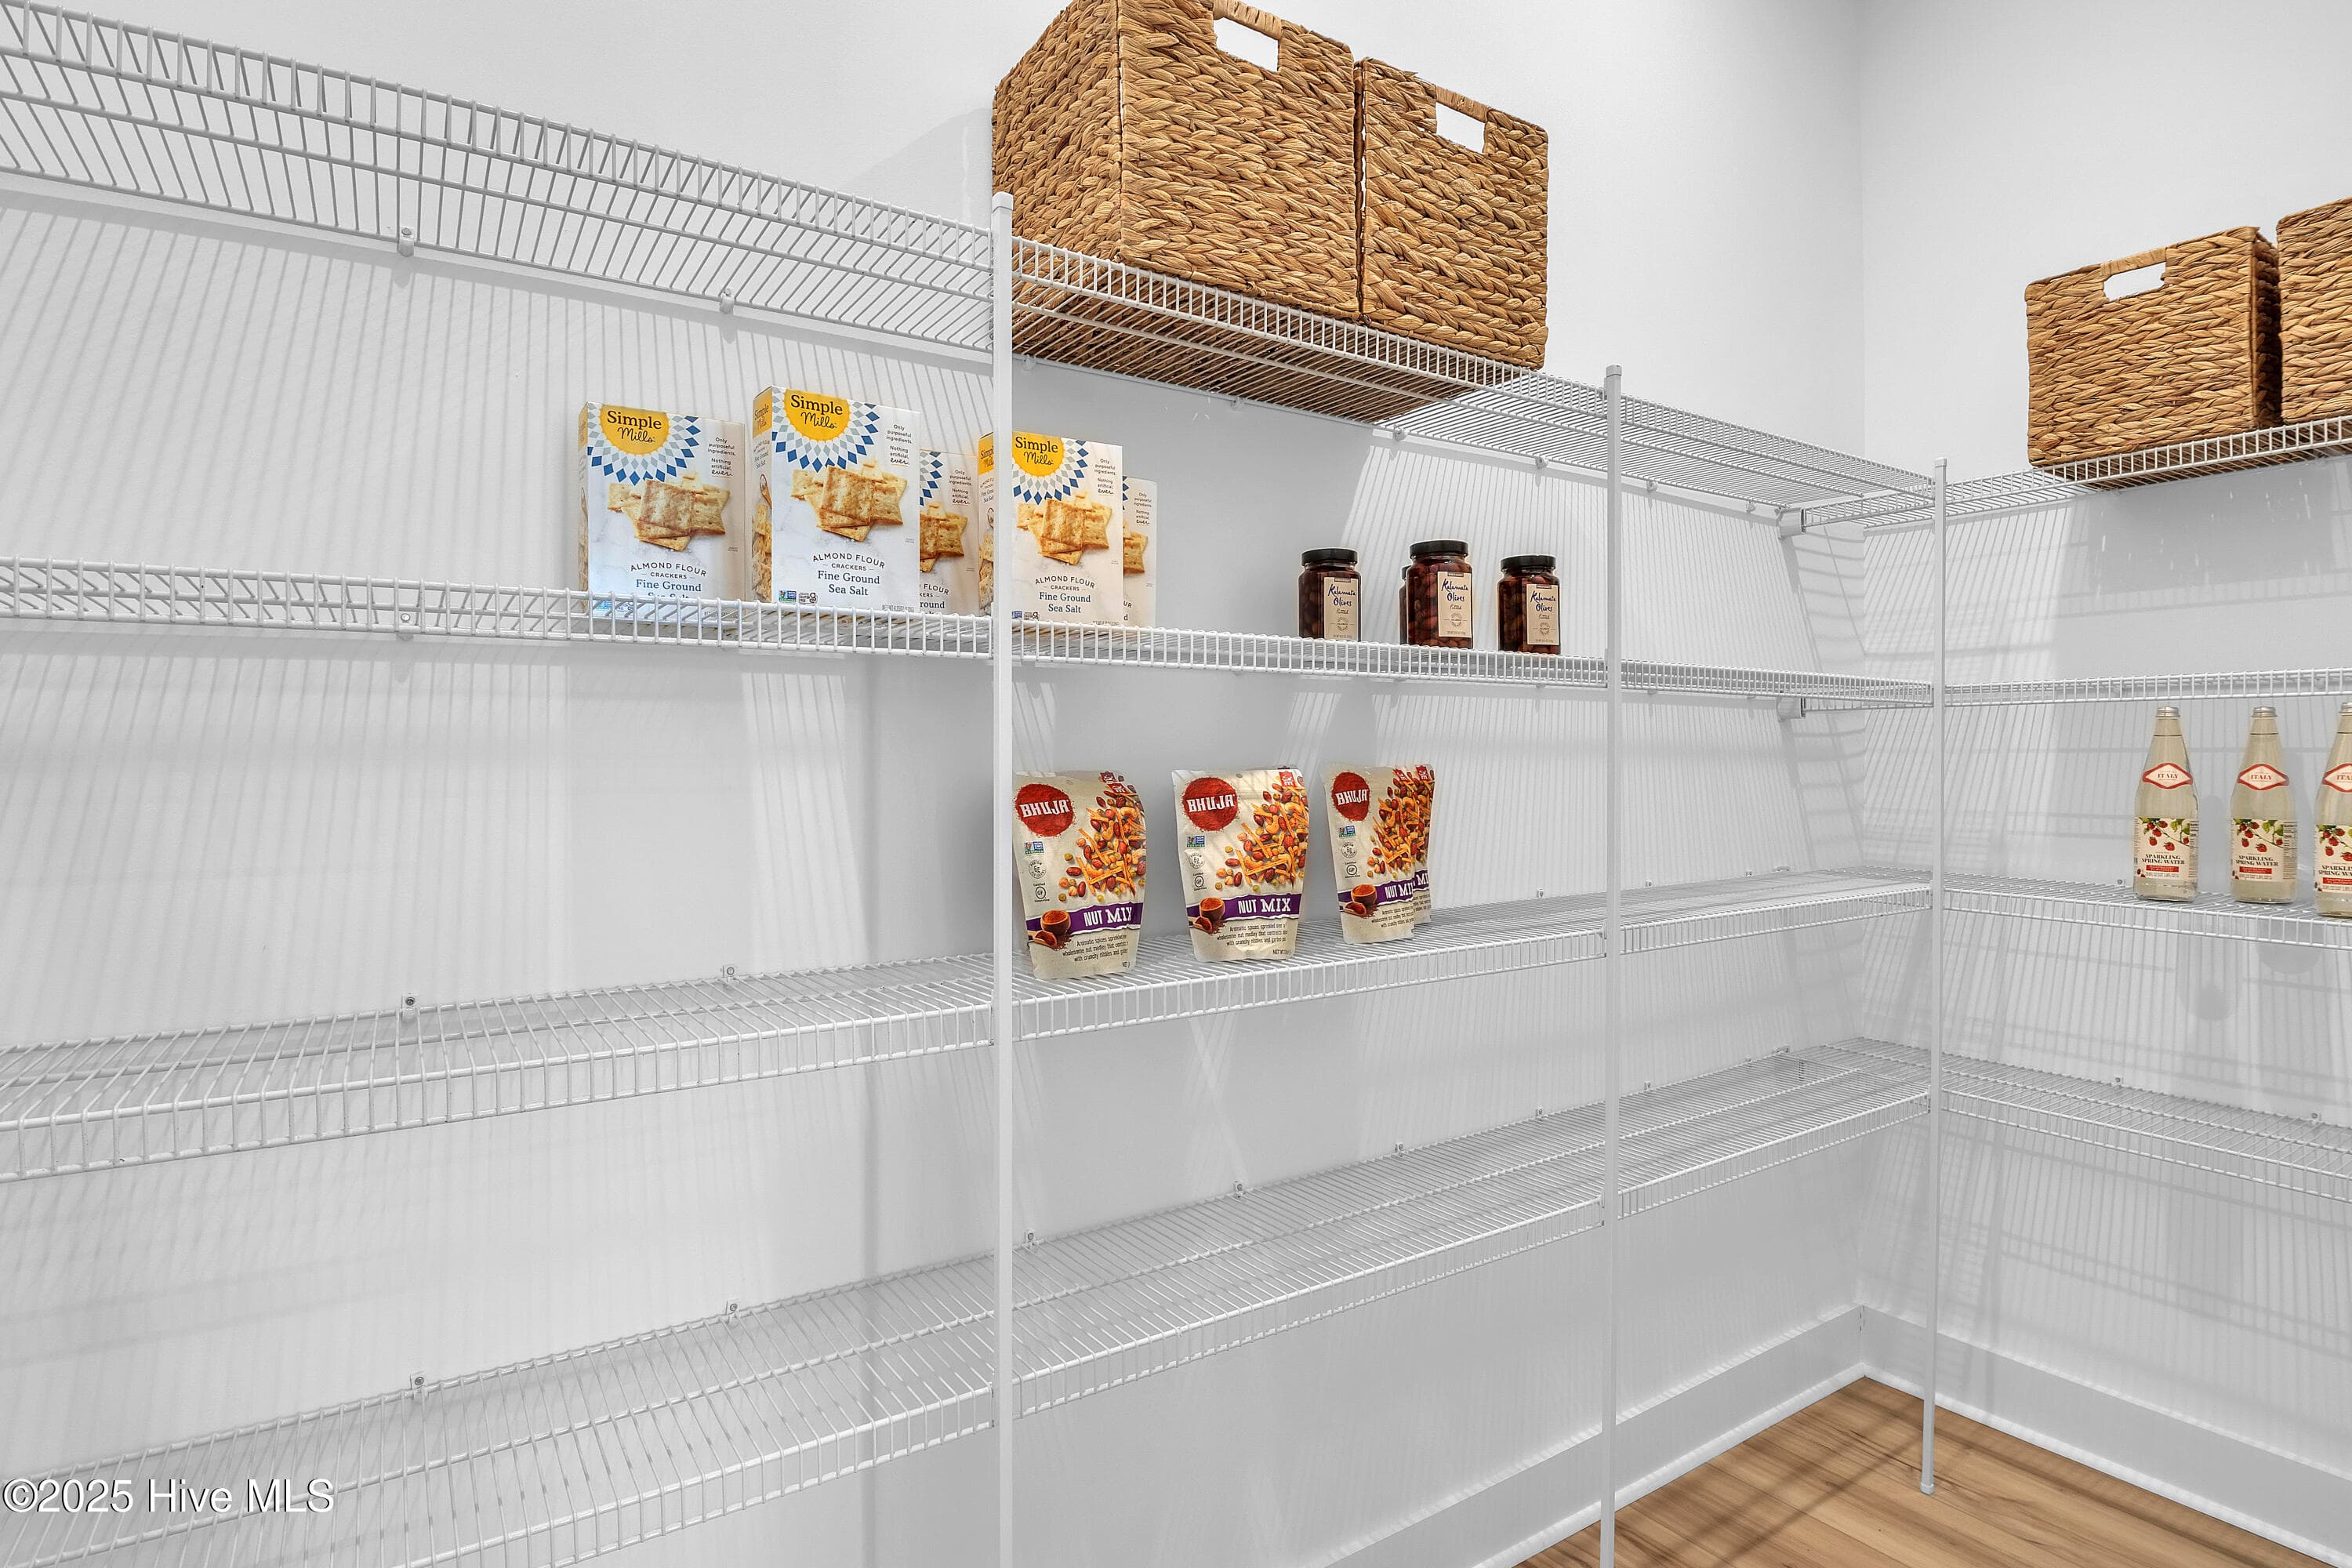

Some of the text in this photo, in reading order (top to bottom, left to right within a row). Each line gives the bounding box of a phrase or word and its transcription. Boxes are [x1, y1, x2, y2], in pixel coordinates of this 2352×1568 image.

[791, 394, 843, 415] Simple
[607, 410, 662, 430] Simple
[800, 412, 836, 428] Mills
[618, 427, 656, 443] Mills
[1015, 436, 1058, 454] Simple
[1023, 452, 1053, 465] Mills
[812, 553, 885, 568] ALMOND FLOUR
[630, 562, 707, 577] ALMOND FLOUR
[818, 570, 880, 584] Fine Ground
[1035, 575, 1095, 588] ALMOND FLOUR
[636, 579, 702, 592] Fine Ground
[829, 584, 869, 596] Sea Salt
[924, 583, 949, 595] FLOUR
[1039, 592, 1091, 603] Fine Ground
[1334, 597, 1352, 607] Olives
[1446, 592, 1465, 602] Olives
[920, 601, 945, 609] round
[1048, 604, 1081, 613] Sea Salt
[1535, 603, 1552, 612] Olives
[1186, 794, 1234, 813] BHUJA
[1335, 789, 1367, 806] BHUJA
[1019, 799, 1069, 818] BHUJA
[1416, 873, 1429, 886] MI
[1385, 882, 1413, 899] NUT MI
[1238, 898, 1291, 914] NUT MIX
[1083, 909, 1103, 927] NUT
